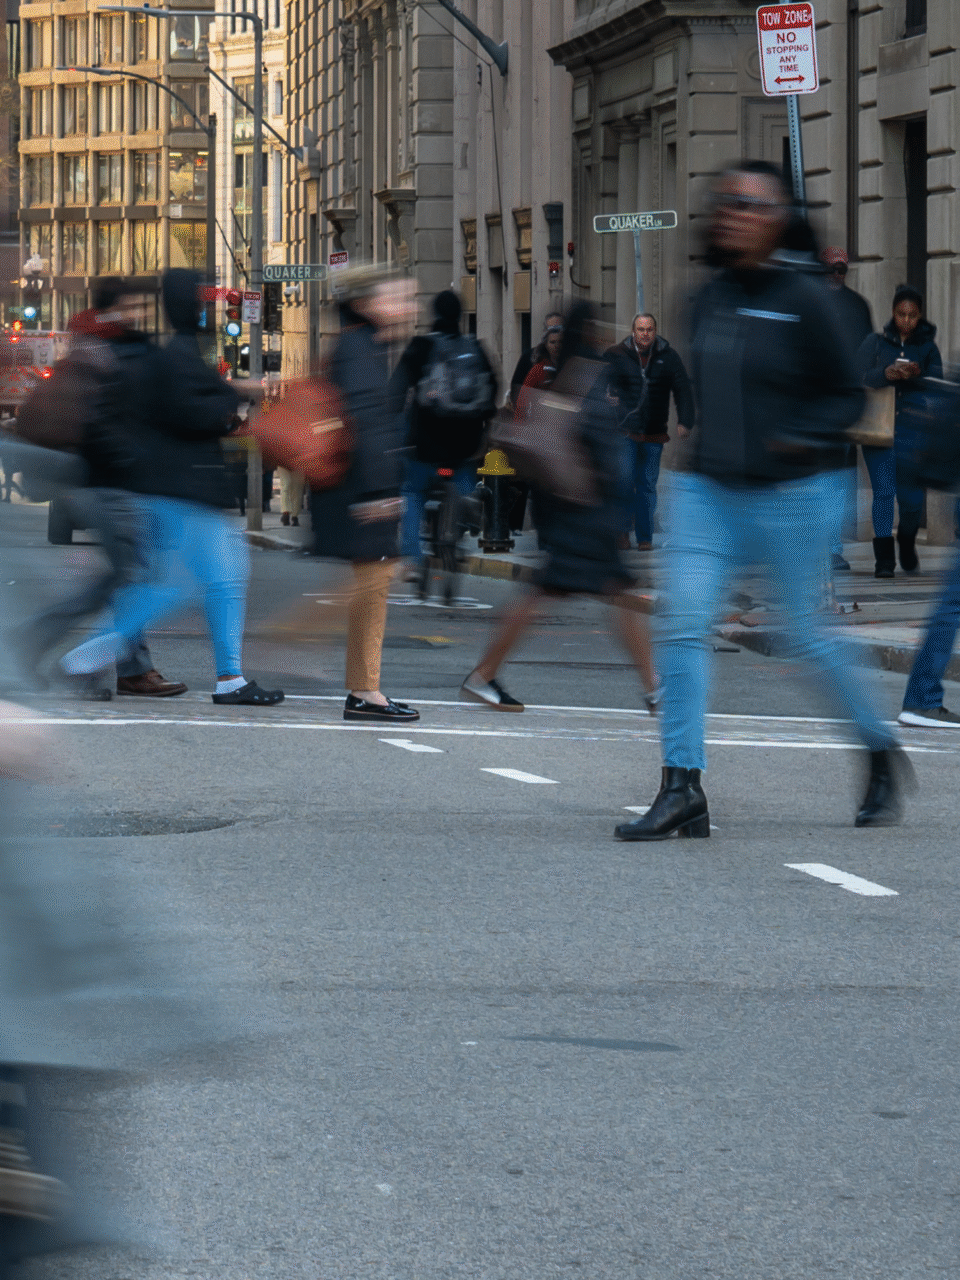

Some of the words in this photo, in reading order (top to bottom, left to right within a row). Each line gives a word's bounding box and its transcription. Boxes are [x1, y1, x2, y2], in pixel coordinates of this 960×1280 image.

[762, 12, 780, 26] TOW
[784, 9, 808, 25] ZONE
[776, 31, 796, 44] NO
[766, 44, 809, 54] STOPPING
[780, 55, 797, 63] ANY
[779, 64, 799, 73] TIME
[609, 215, 653, 230] QUAKER
[265, 266, 310, 279] QUAKER
